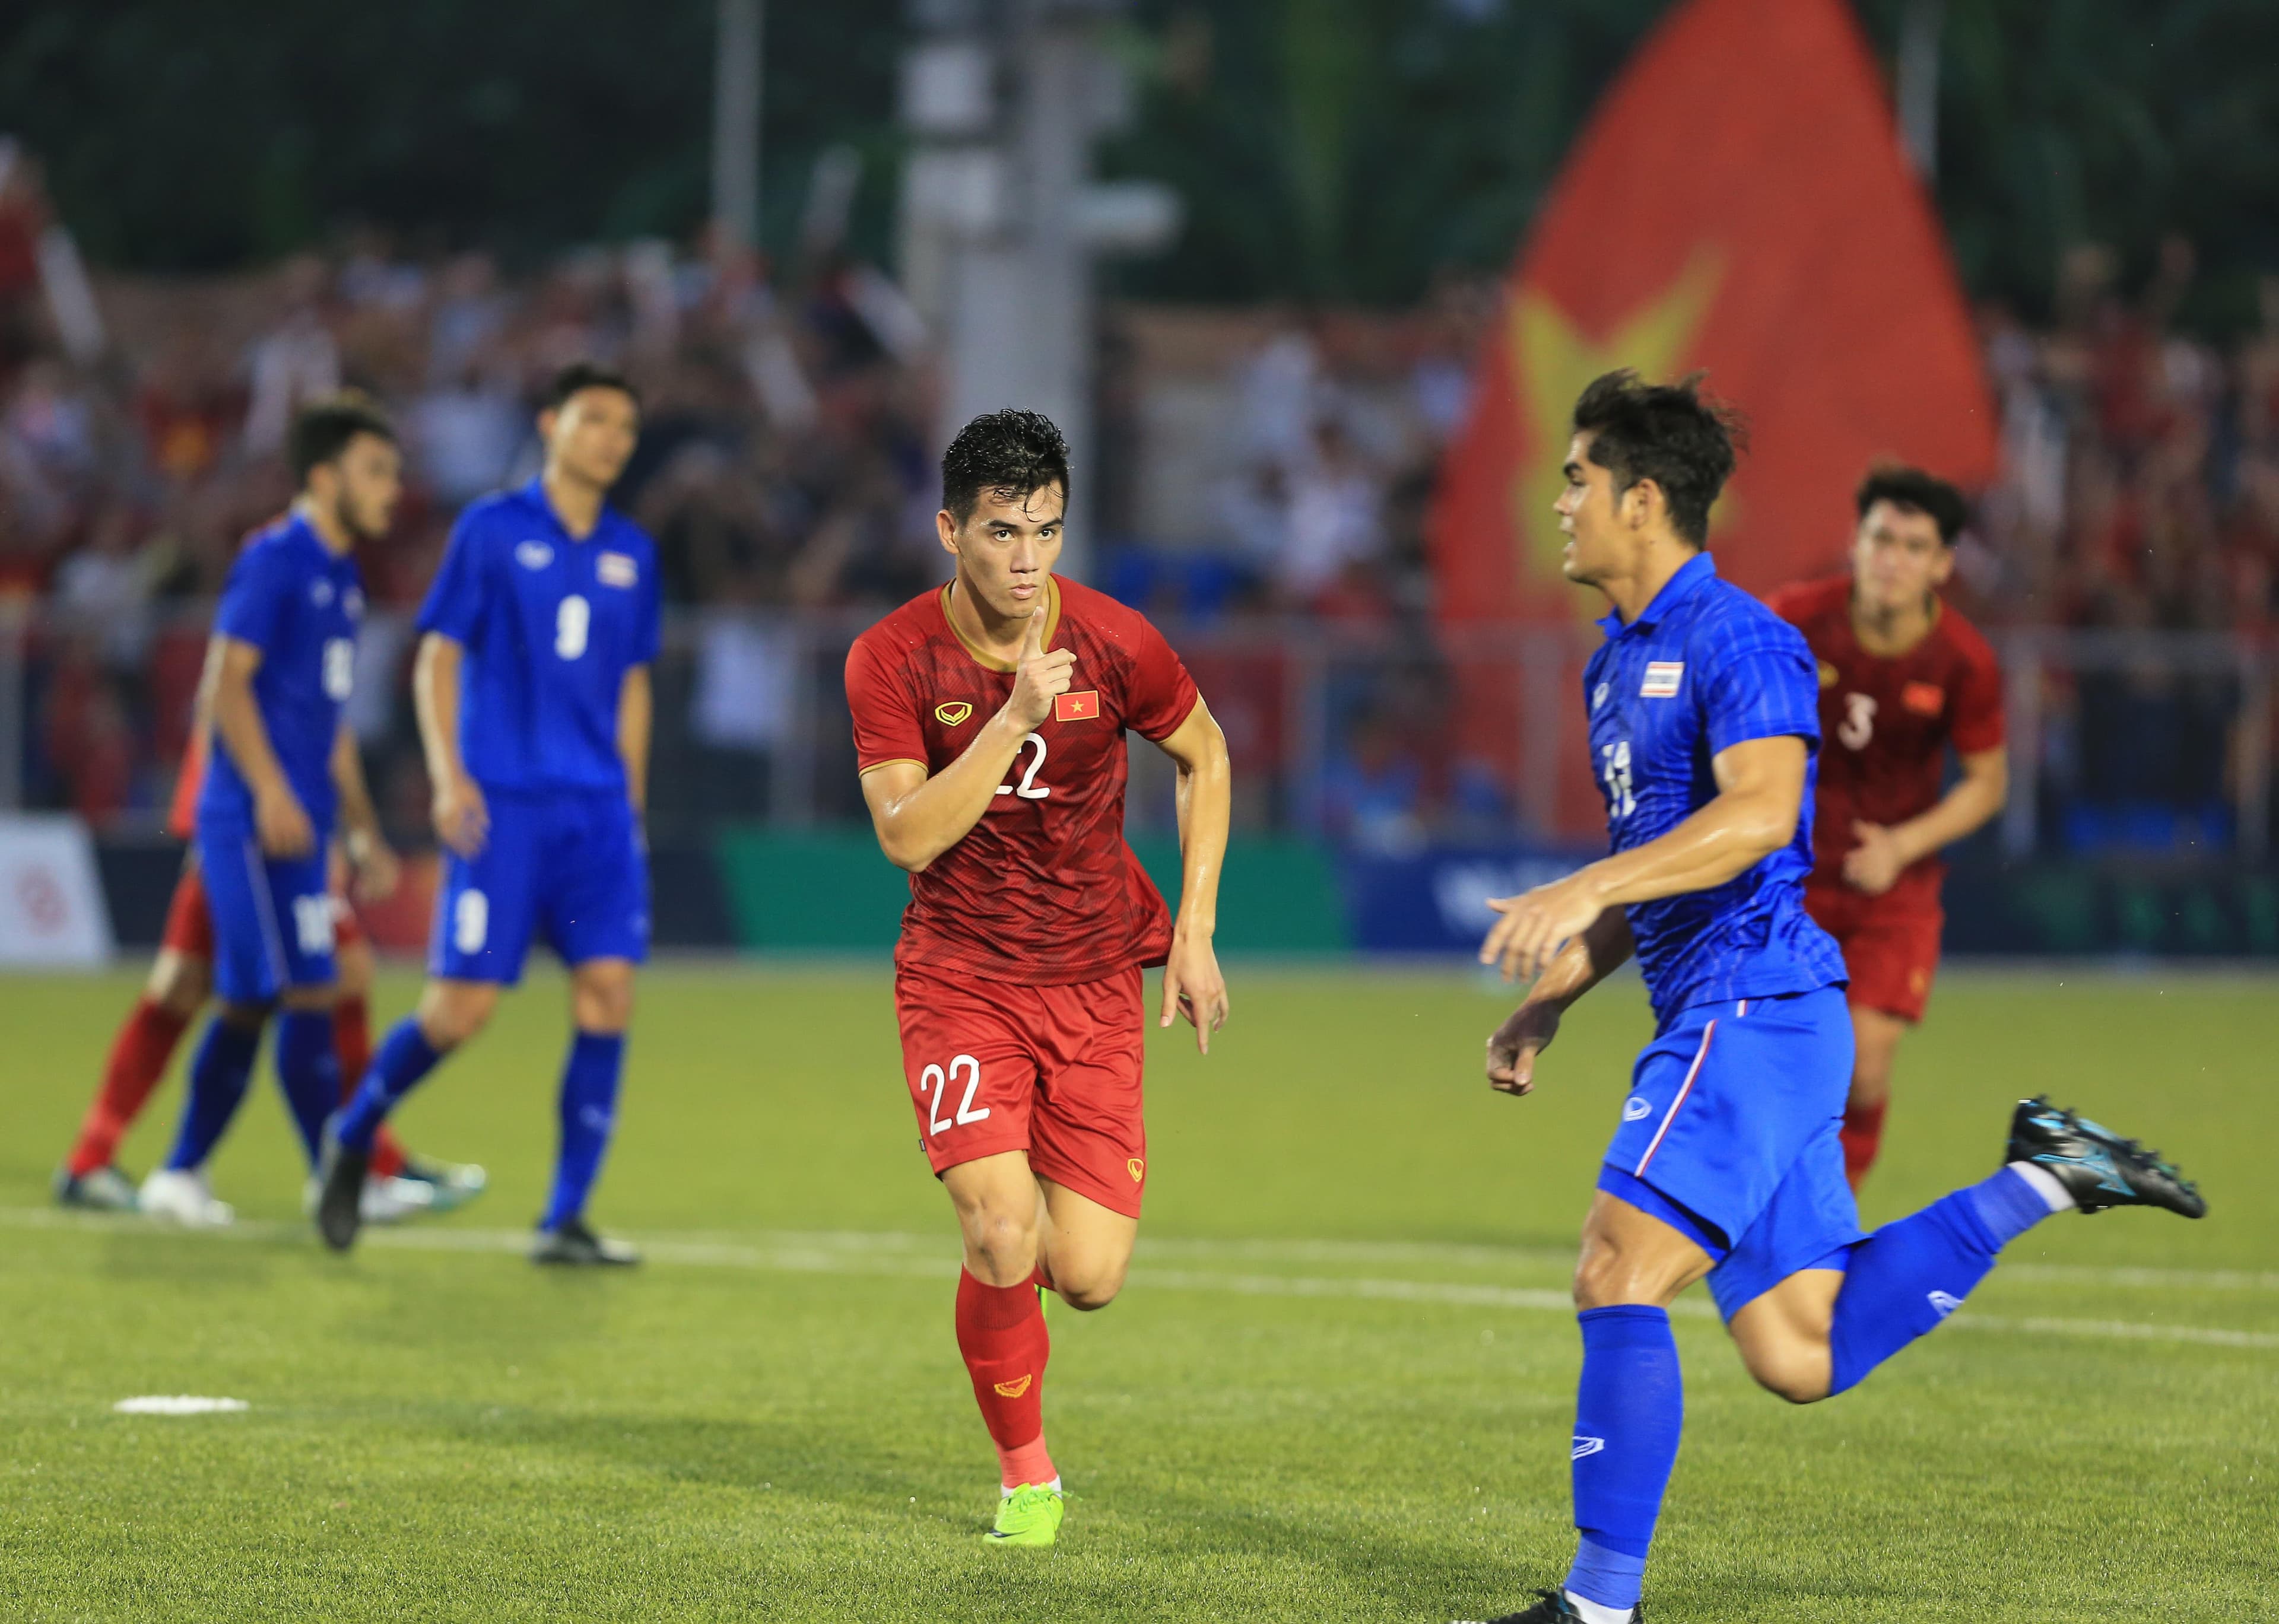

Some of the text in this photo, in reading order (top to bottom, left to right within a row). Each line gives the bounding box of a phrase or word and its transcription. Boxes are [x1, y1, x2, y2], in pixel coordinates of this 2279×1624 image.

[1837, 692, 1878, 750] 3
[995, 732, 1050, 799] 2
[921, 1054, 991, 1136] 22
